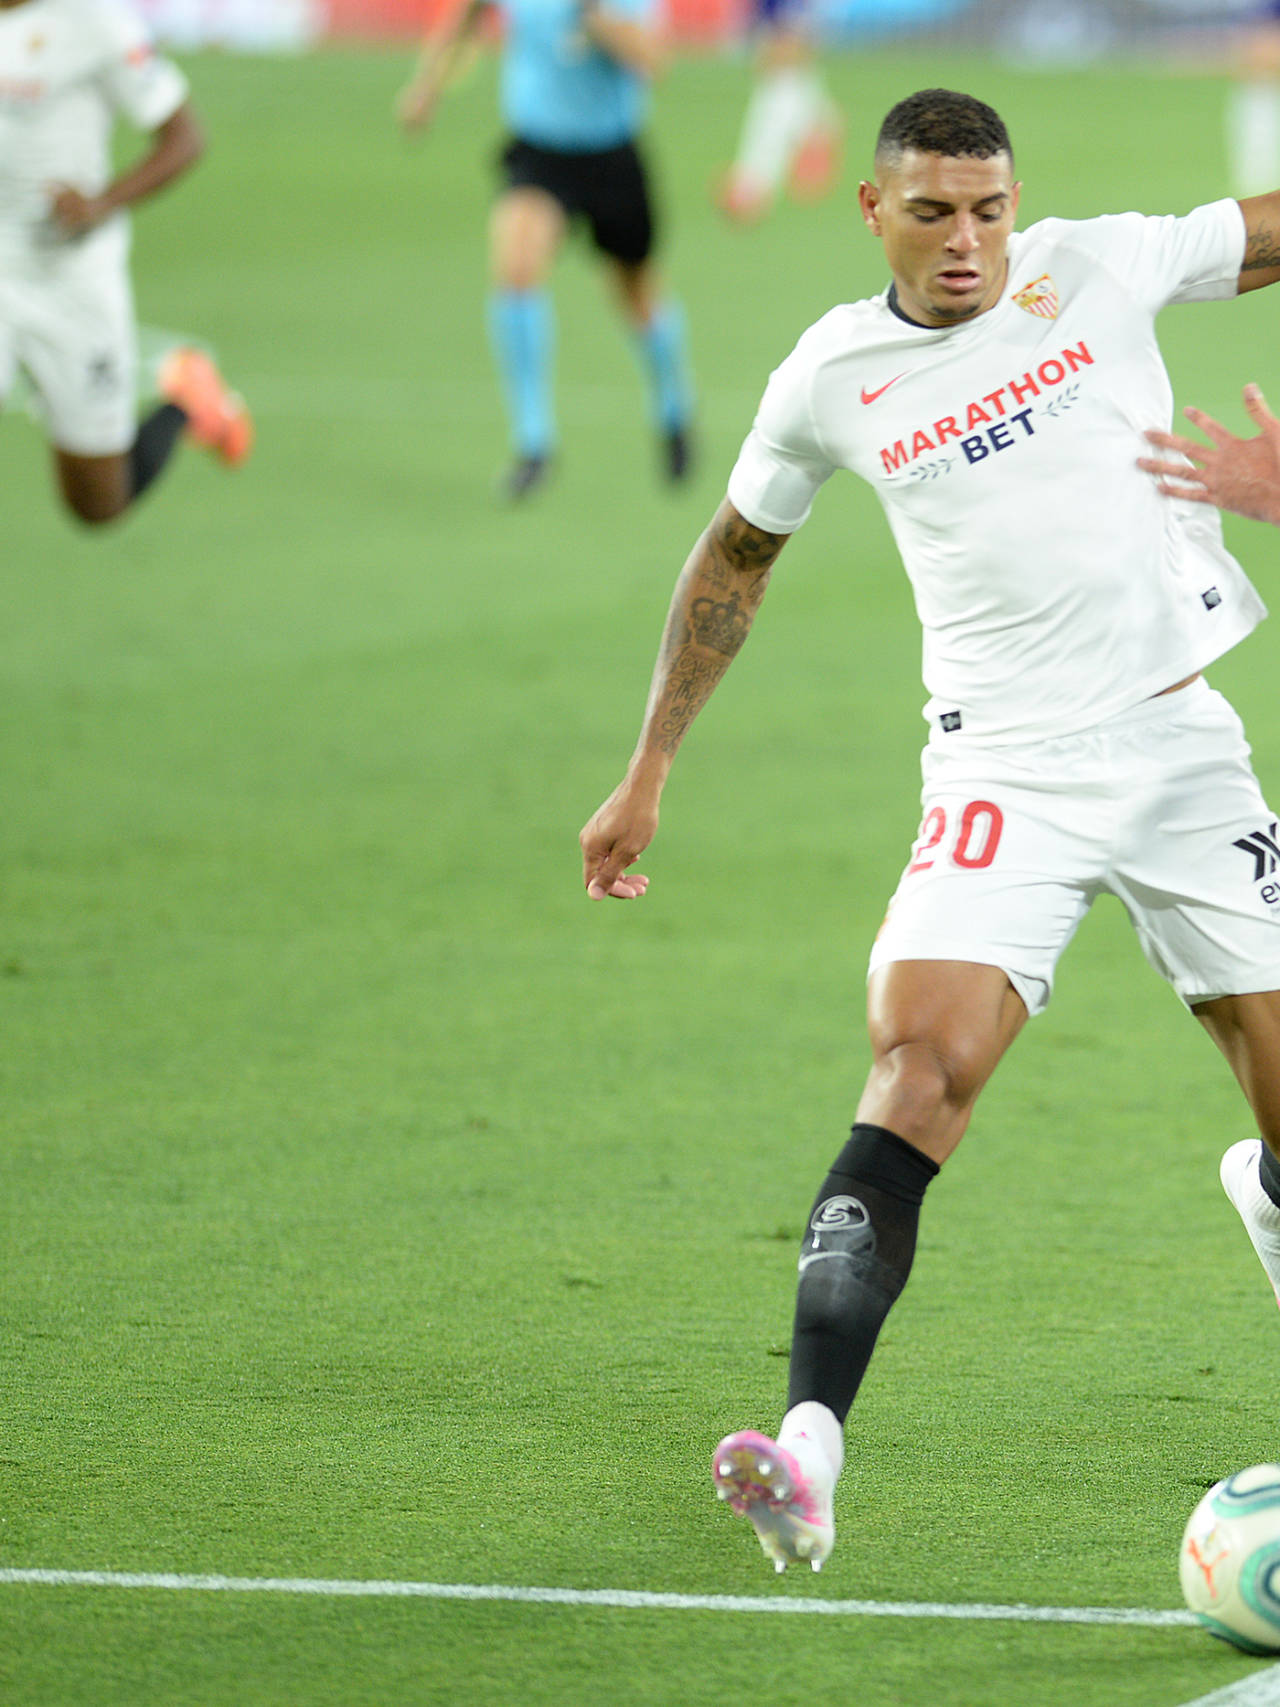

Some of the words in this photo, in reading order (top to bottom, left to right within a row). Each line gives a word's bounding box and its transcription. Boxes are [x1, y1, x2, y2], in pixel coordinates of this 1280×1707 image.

[880, 341, 1095, 474] MARATHON
[960, 408, 1035, 465] BET
[906, 800, 1004, 877] 20
